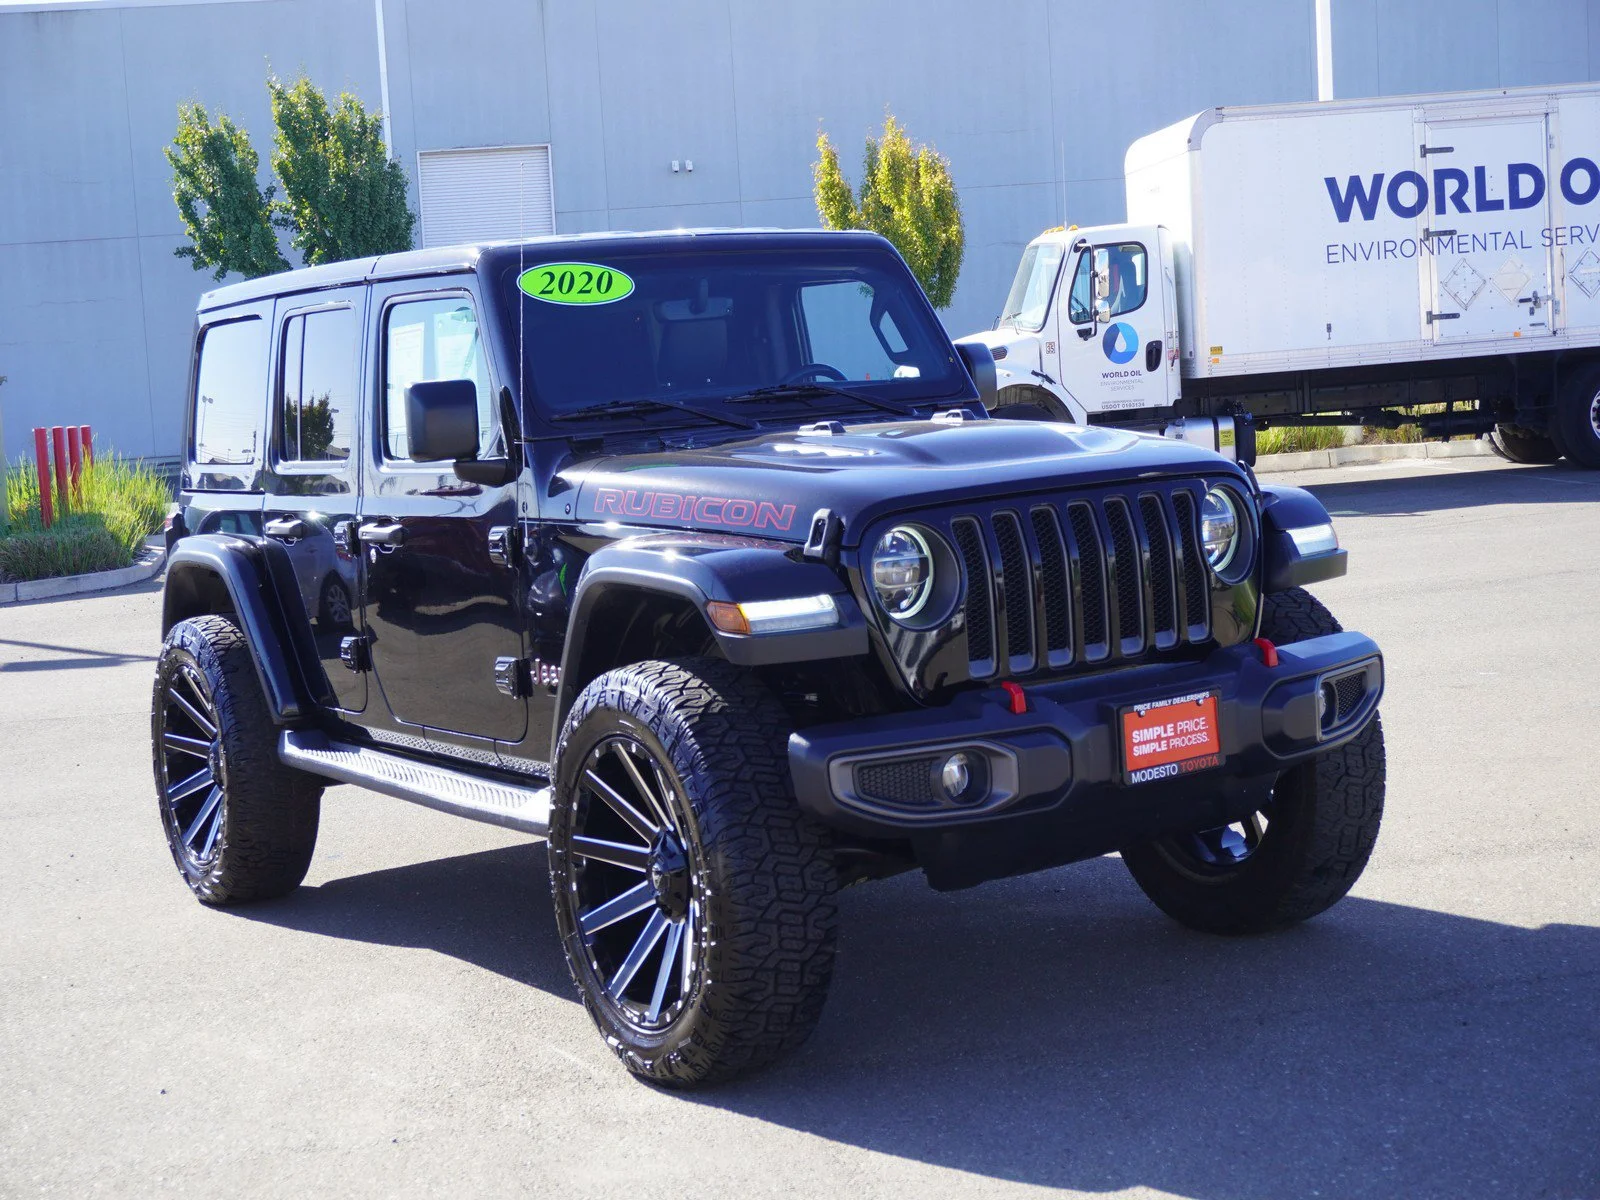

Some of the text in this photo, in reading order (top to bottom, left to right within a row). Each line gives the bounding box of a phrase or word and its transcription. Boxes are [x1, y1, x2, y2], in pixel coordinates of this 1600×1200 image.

[1324, 162, 1546, 223] WORLD
[1326, 230, 1532, 264] ENVIRONMENTAL
[538, 270, 613, 295] 2020
[1100, 379, 1144, 387] ENVIRONMENTAL
[1101, 371, 1129, 379] WORLD
[594, 487, 796, 531] RUBICON
[529, 658, 562, 686] Jee
[1133, 691, 1210, 712] PRICE FAMILY DEALERSHIPS
[1132, 717, 1209, 743] SIMPLE PRICE.
[1133, 732, 1210, 757] SIMPLE PROCESS.
[1131, 755, 1219, 784] MODESTO TOYOTA
